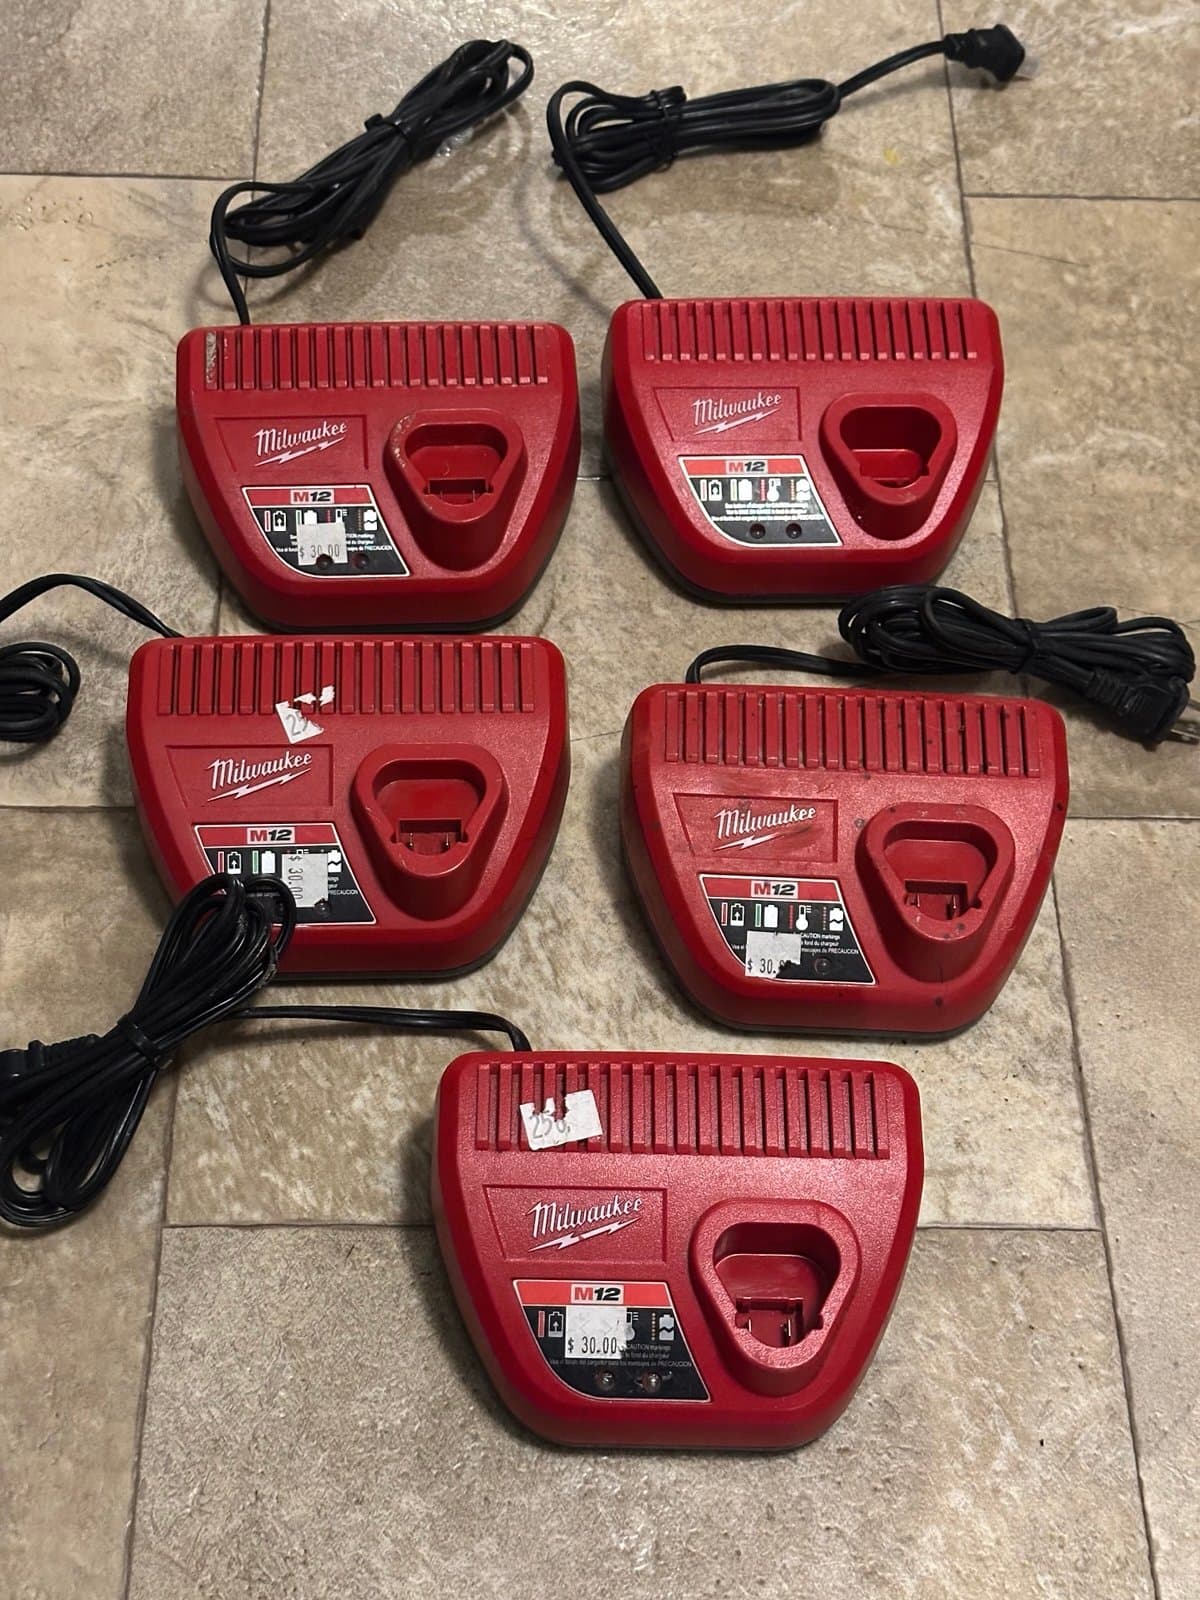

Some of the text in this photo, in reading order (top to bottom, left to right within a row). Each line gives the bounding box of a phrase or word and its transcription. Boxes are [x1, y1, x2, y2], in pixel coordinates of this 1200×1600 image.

[691, 391, 782, 426] Milwaukee
[253, 420, 348, 457] Milwaukee
[729, 461, 766, 473] M12
[293, 491, 332, 502] M12
[310, 543, 340, 558] 3000
[207, 751, 313, 790] Milwaukee
[713, 804, 817, 840] Milwaukee
[250, 829, 292, 842] M12
[754, 883, 796, 896] M12
[527, 1194, 643, 1238] Milwaukee
[574, 1287, 621, 1301] M12
[568, 1336, 617, 1354] $ 30.00
